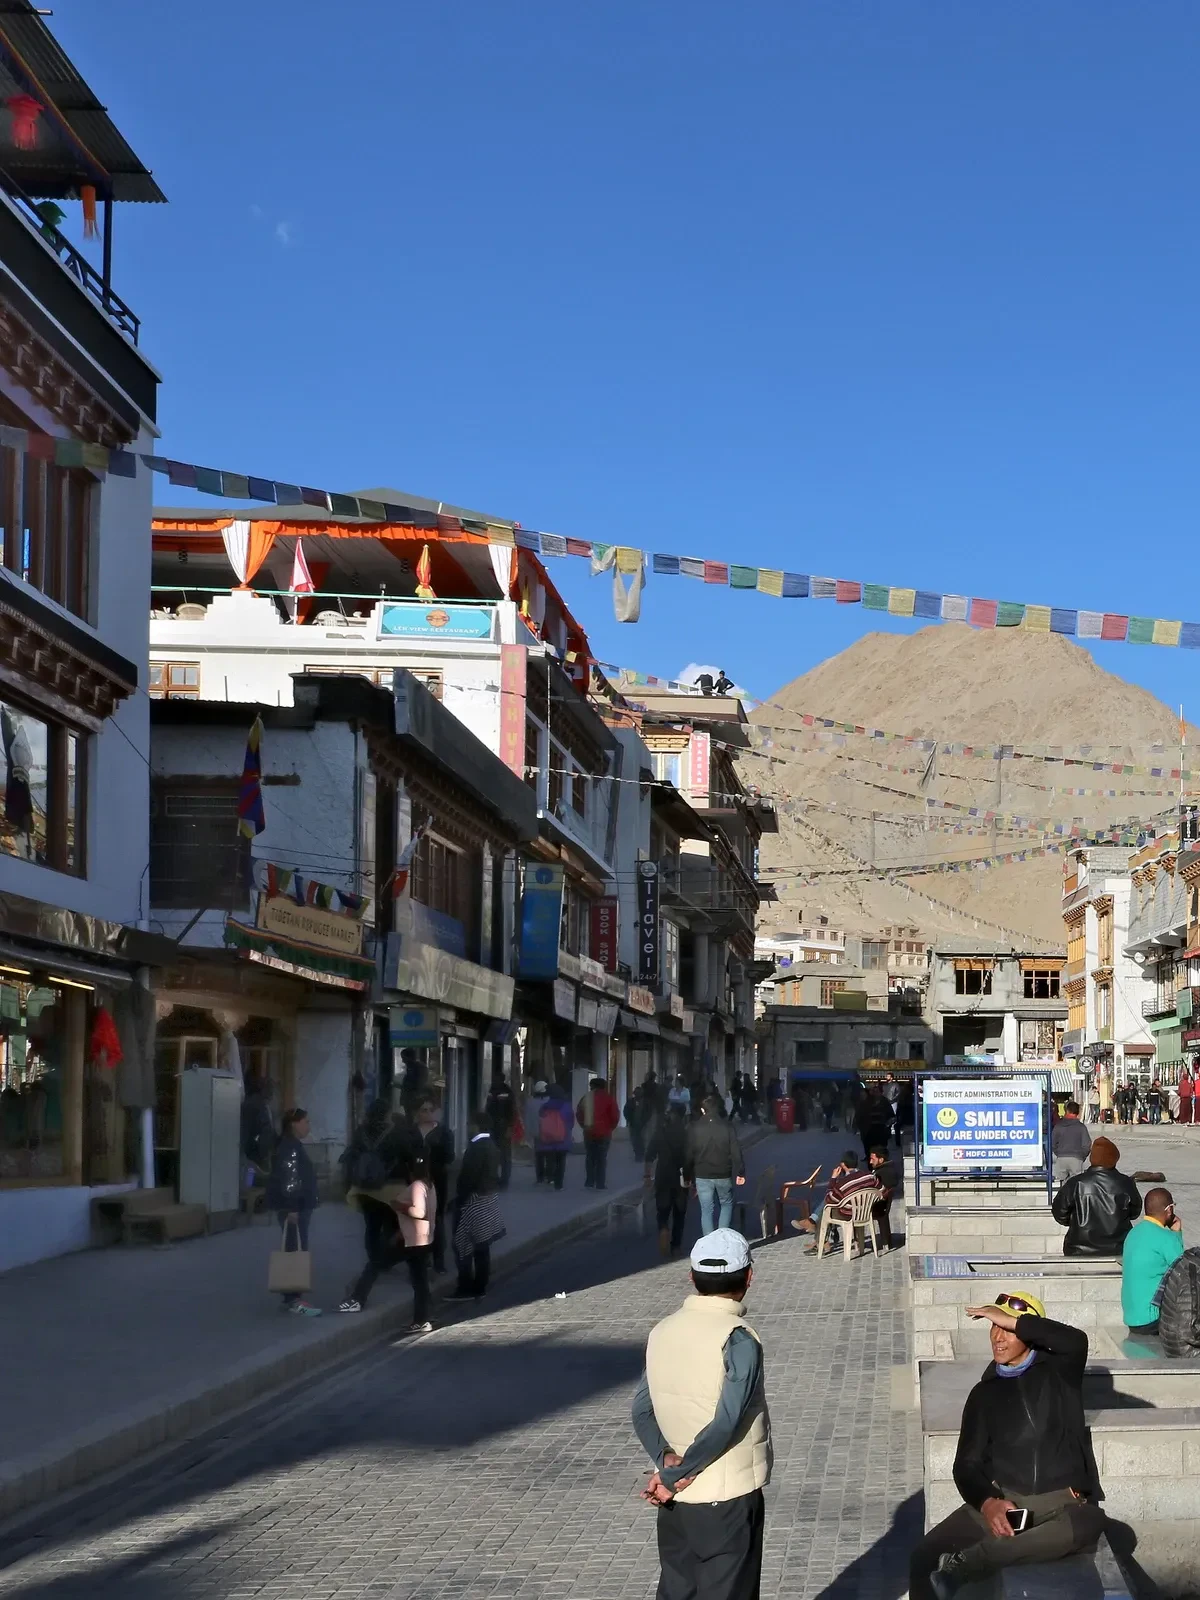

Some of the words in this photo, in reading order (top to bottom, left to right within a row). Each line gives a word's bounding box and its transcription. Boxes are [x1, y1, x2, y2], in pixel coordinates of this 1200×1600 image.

[271, 907, 300, 928] TIBETAN
[301, 916, 330, 937] REFUGEE
[600, 908, 609, 935] BOOK
[643, 880, 655, 968] Travel
[964, 1090, 1019, 1098] ADMINISTRATION
[1020, 1090, 1033, 1098] LEH
[964, 1110, 1026, 1127] SMILE
[931, 1130, 951, 1141] YOU
[953, 1130, 972, 1140] ARE
[974, 1130, 1007, 1140] UNDER
[1009, 1129, 1034, 1140] CCTV
